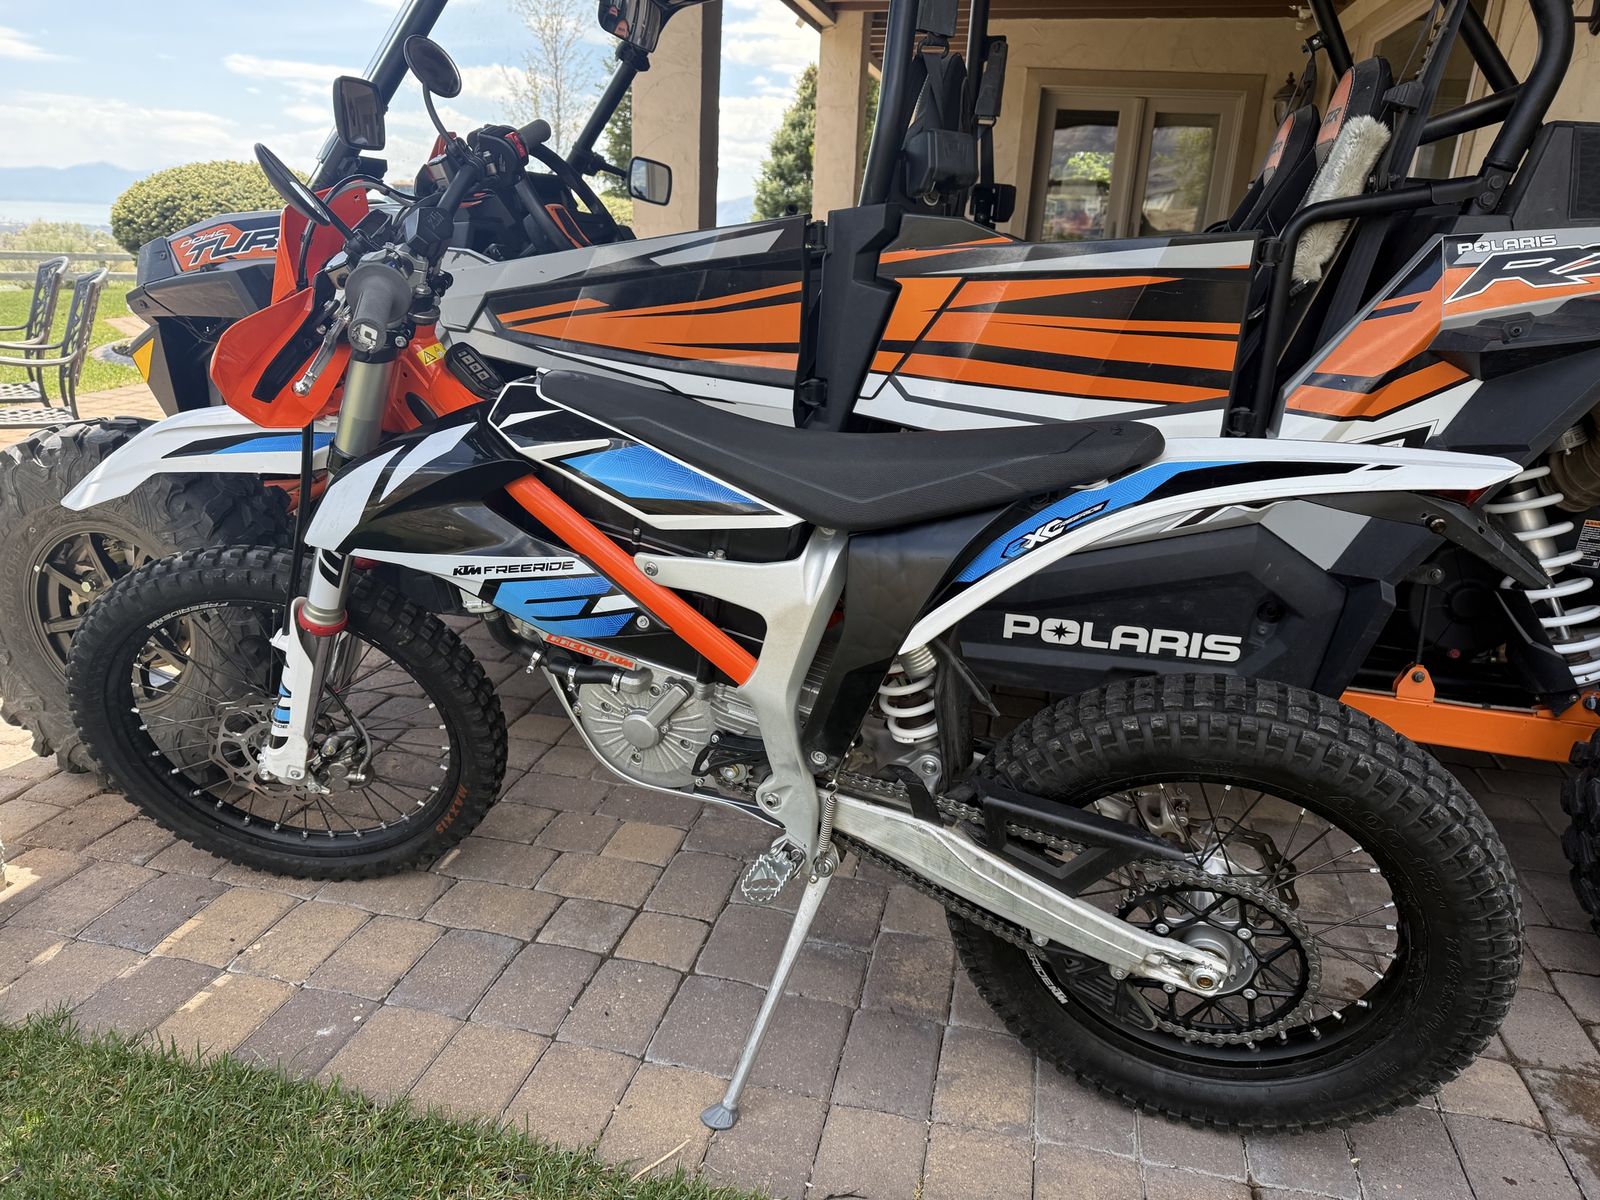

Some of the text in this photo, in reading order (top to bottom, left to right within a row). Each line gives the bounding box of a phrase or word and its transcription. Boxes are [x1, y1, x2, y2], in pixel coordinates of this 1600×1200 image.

[180, 228, 228, 248] DOHC
[1457, 233, 1557, 255] POLARIS
[452, 560, 575, 576] KTM FREERIDE
[1002, 613, 1243, 662] POLARIS
[435, 783, 468, 834] MAXXIS
